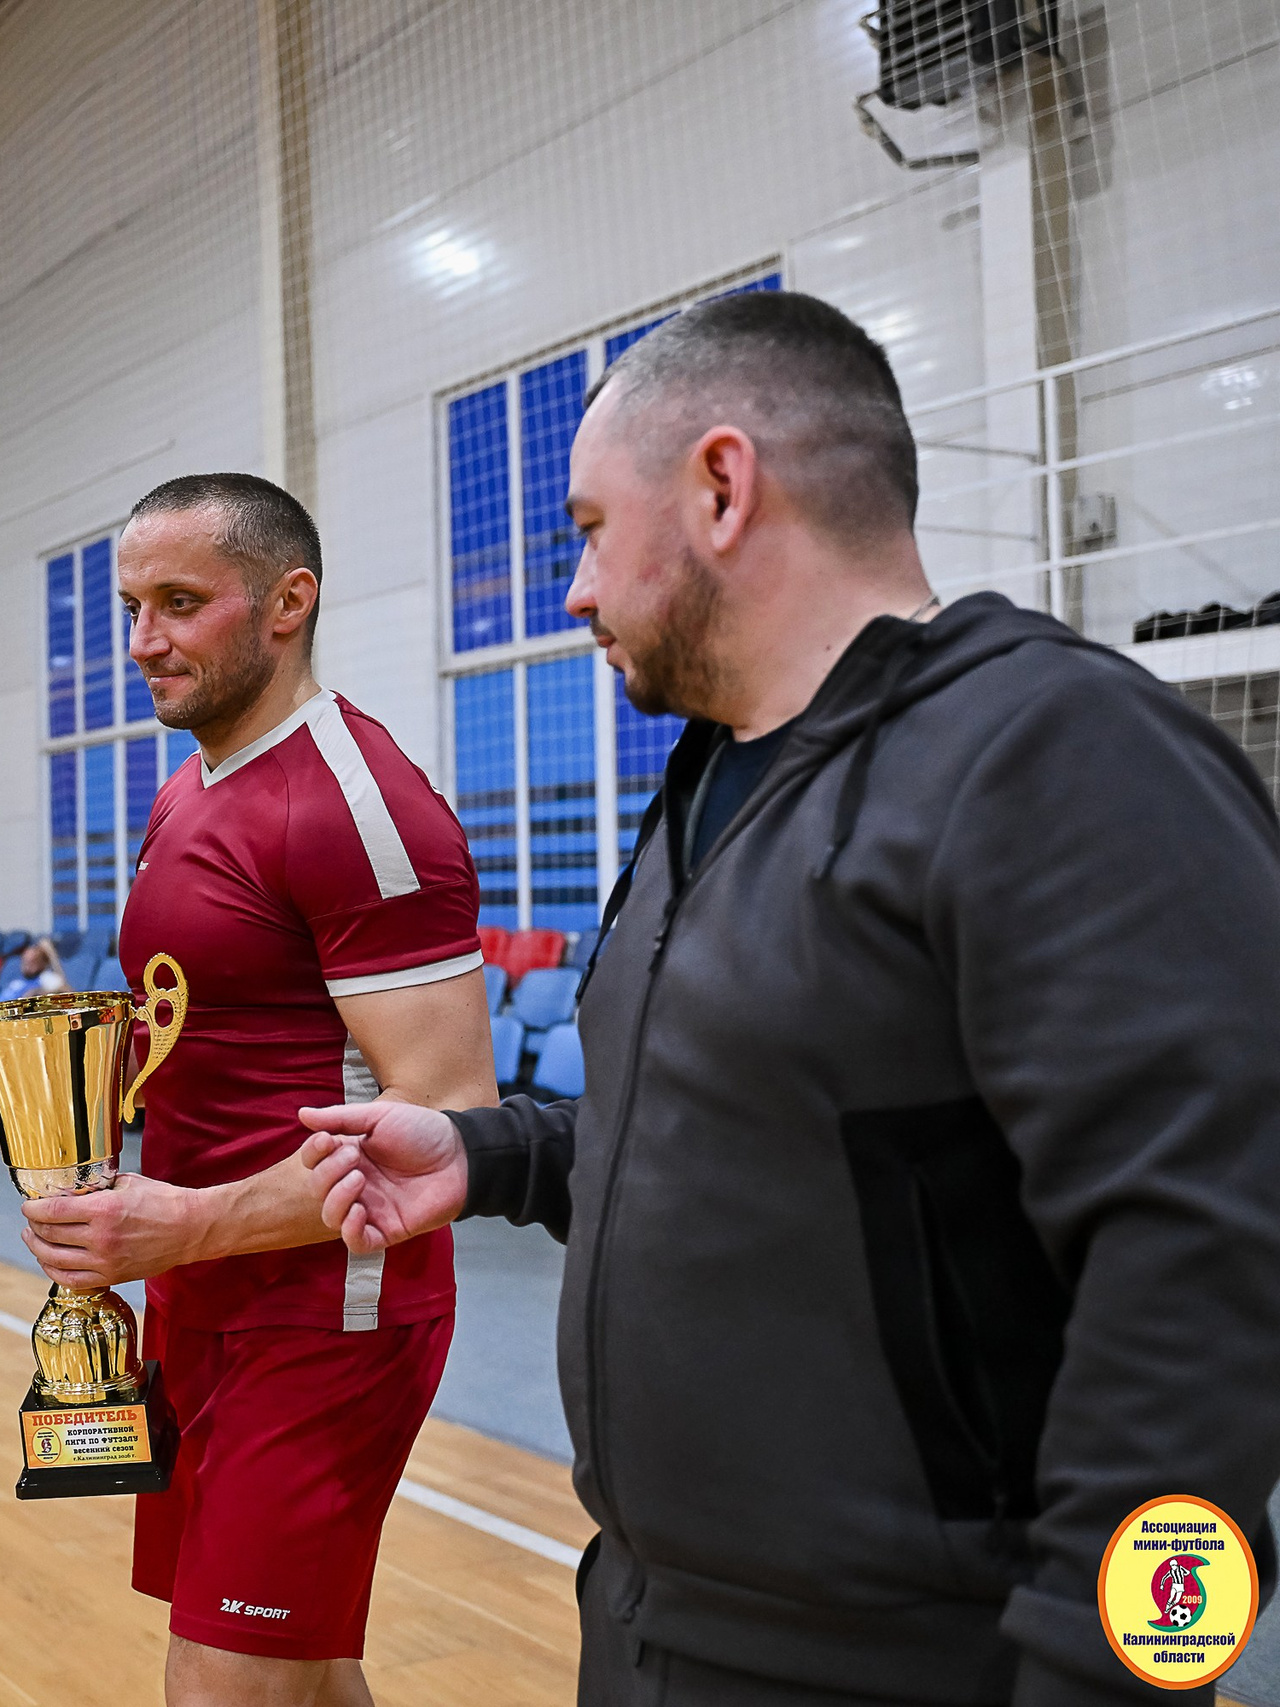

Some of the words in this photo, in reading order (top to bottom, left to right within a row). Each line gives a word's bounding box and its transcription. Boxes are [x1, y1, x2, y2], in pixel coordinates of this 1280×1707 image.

[31, 1409, 138, 1427] ПОБЕДИТЕЛЬ
[67, 1425, 134, 1436] КОРПОРАТИВНОЙ
[220, 1598, 245, 1614] 2K
[244, 1605, 291, 1620] SPORT
